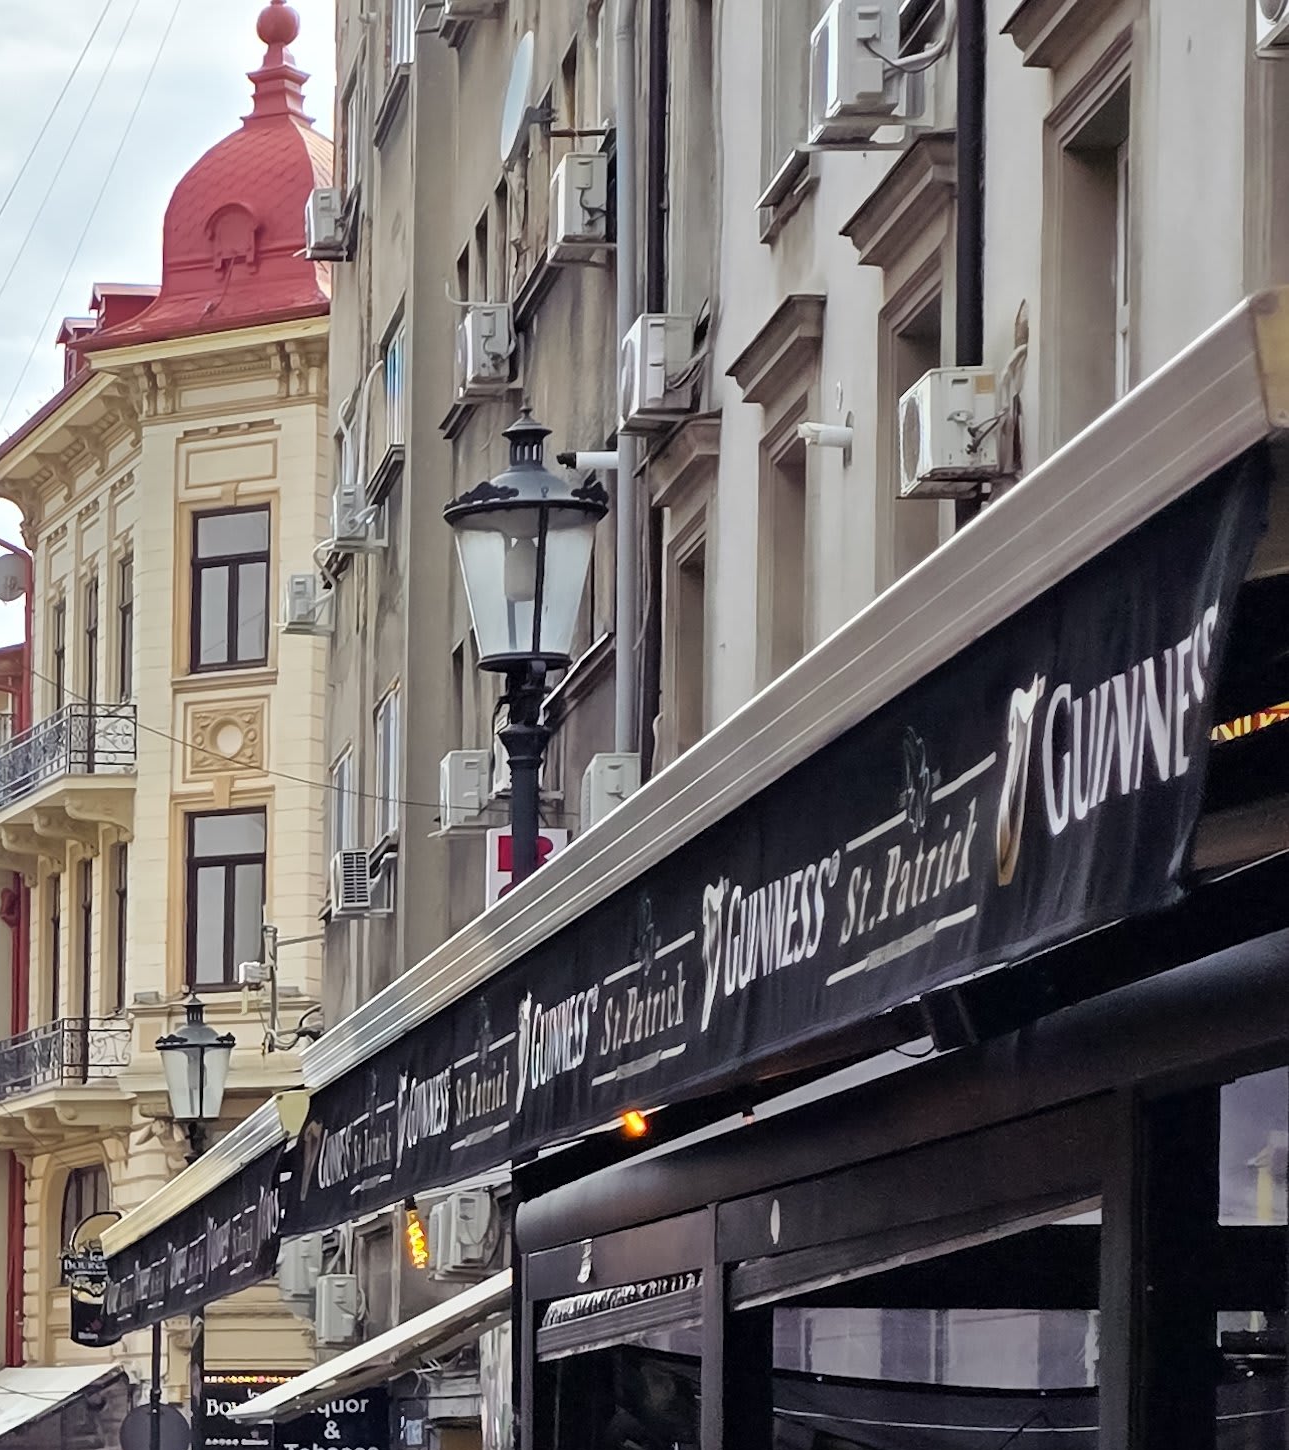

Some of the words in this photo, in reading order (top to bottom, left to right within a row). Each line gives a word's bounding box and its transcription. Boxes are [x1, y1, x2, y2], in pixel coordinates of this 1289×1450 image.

[724, 857, 832, 997] GUINNESS
[310, 1398, 369, 1418] quor
[323, 1420, 342, 1439] &
